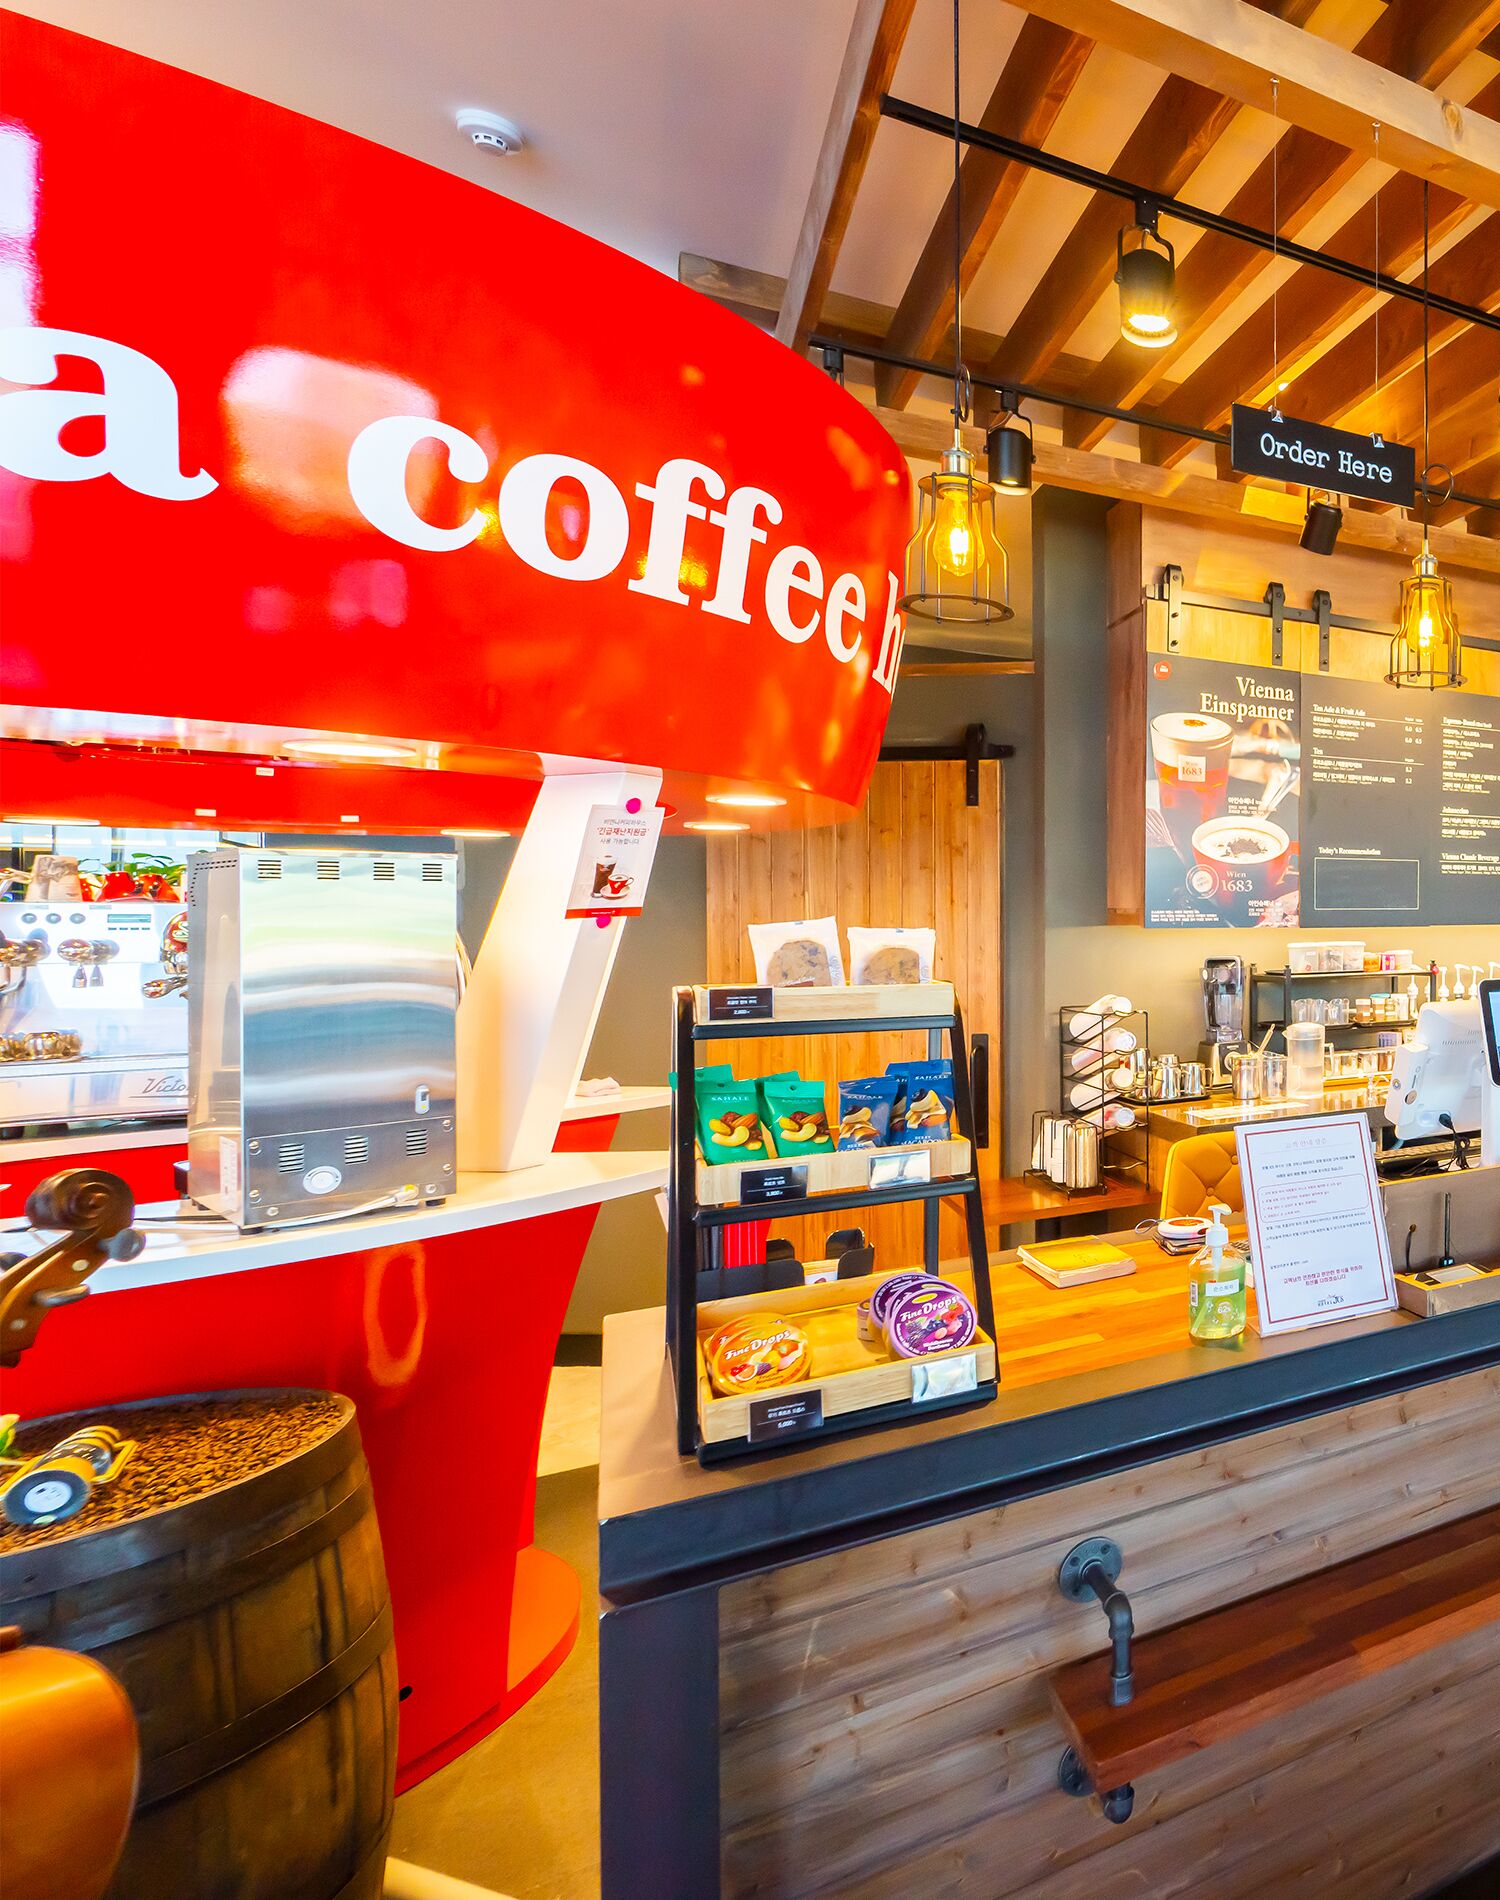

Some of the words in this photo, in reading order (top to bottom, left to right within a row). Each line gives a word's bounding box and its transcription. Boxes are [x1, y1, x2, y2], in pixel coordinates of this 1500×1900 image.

[1260, 432, 1330, 468] Order
[1338, 450, 1393, 484] Here
[347, 415, 867, 663] coffee
[872, 570, 906, 704] h
[1236, 676, 1294, 702] Vienna
[1200, 693, 1294, 722] Einspanner
[1182, 767, 1202, 775] 1683
[1221, 880, 1253, 892] 1683
[900, 1309, 922, 1322] Fine
[922, 1297, 957, 1315] Drops
[724, 1345, 750, 1360] Fine
[750, 1330, 790, 1350] Drops
